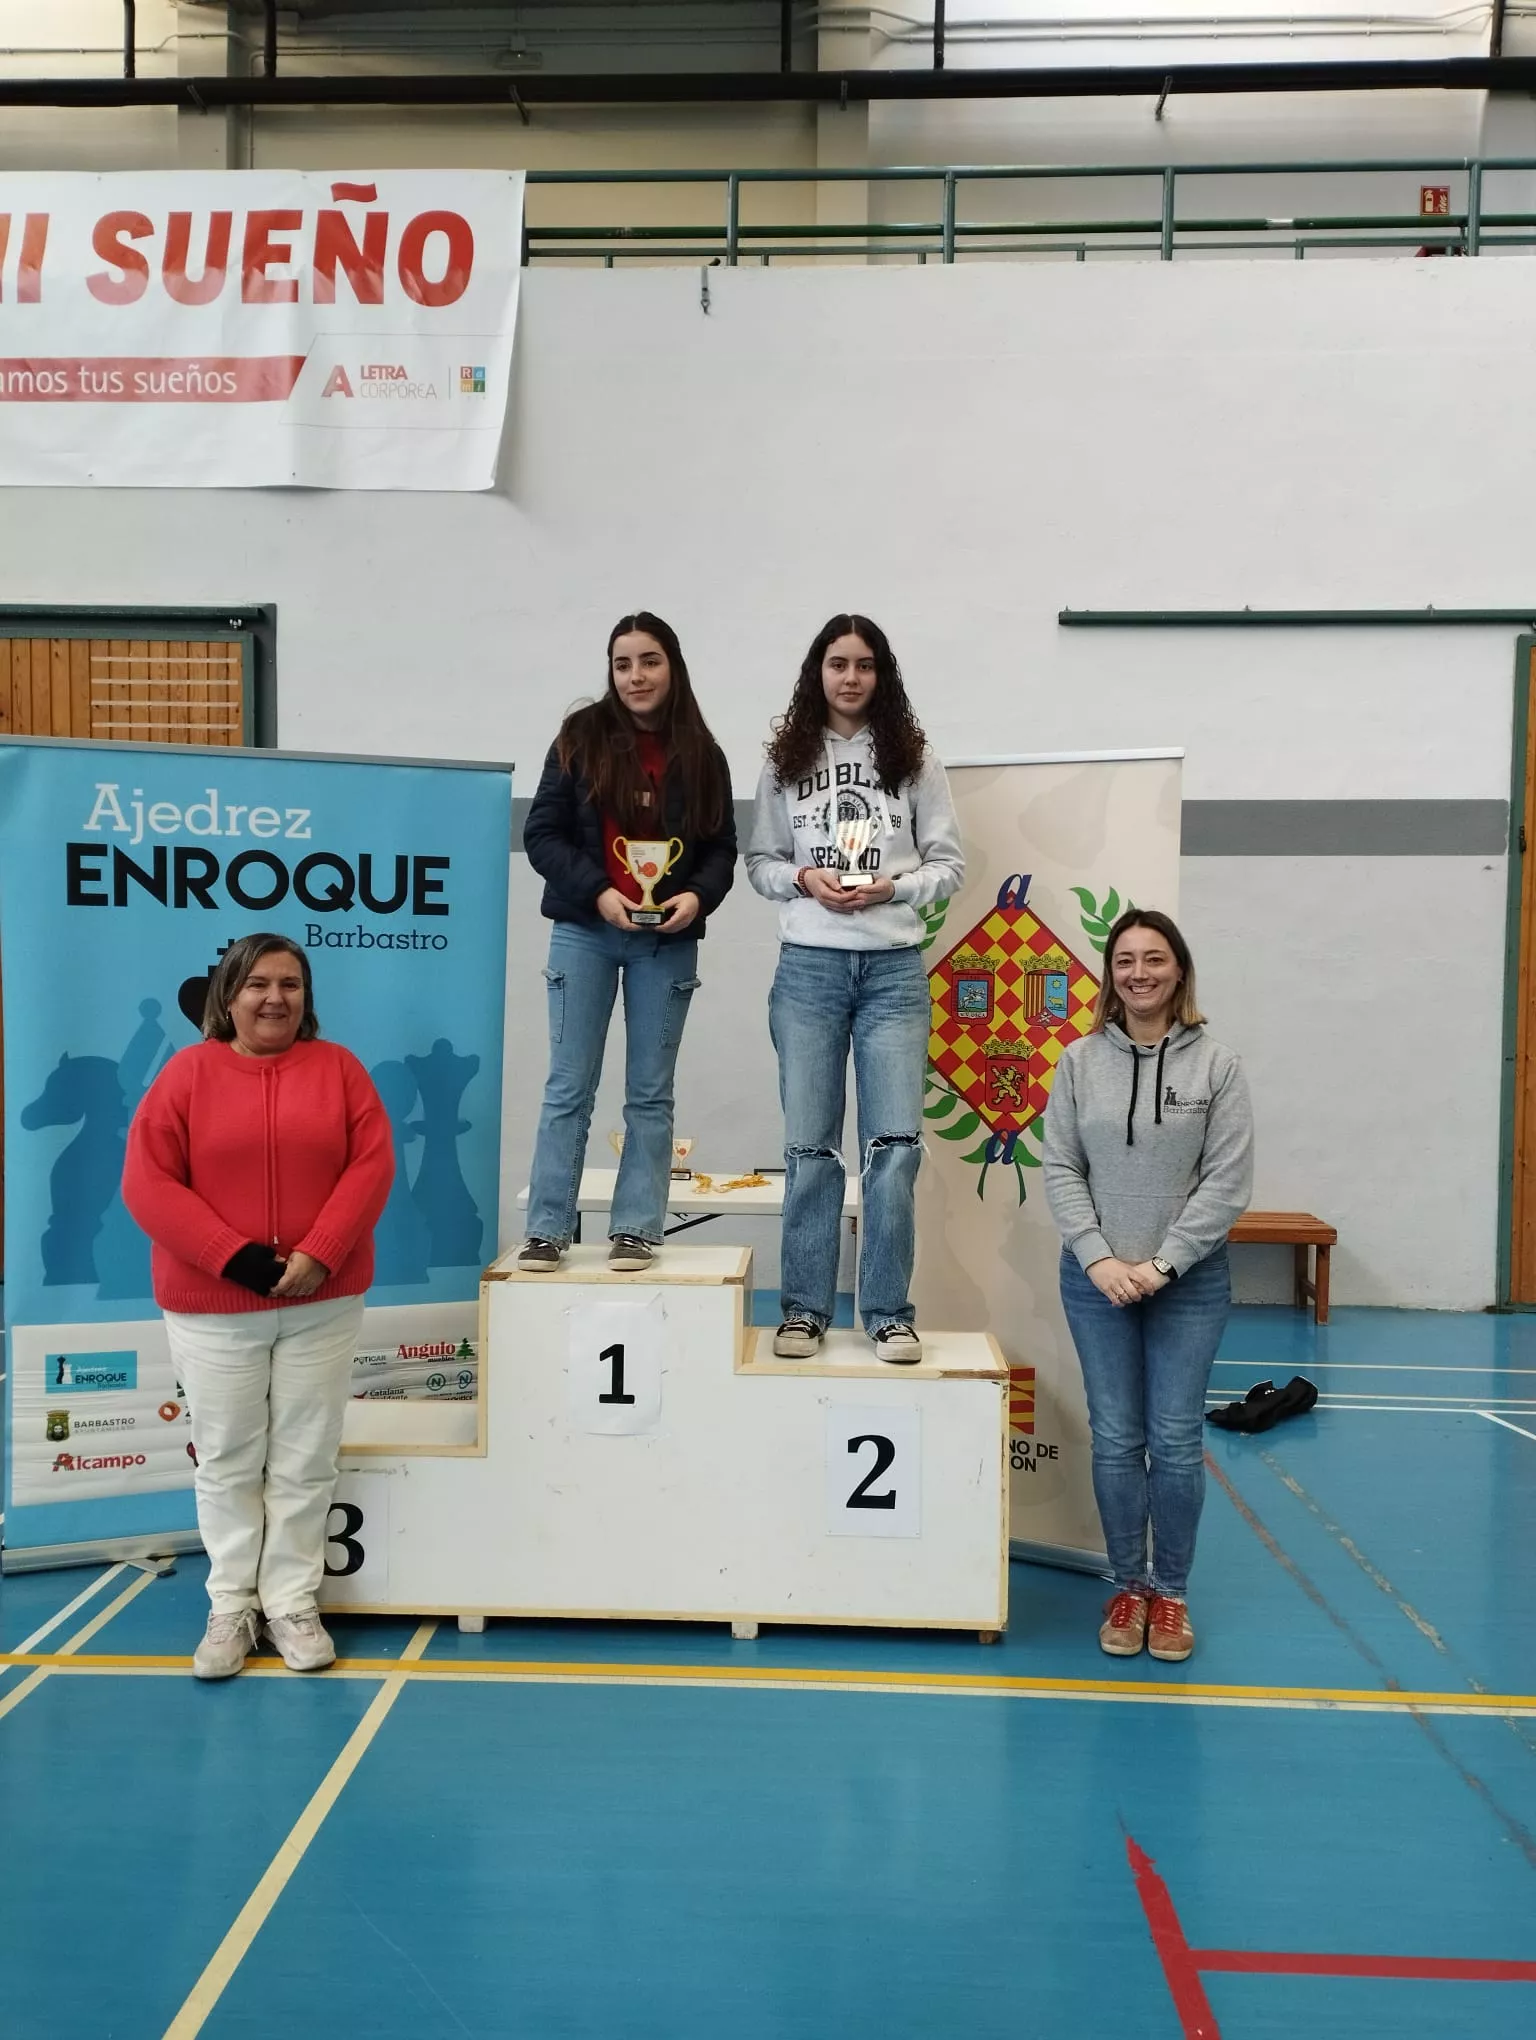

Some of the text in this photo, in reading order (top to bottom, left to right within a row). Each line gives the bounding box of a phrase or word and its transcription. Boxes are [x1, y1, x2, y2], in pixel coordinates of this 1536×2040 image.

[86, 182, 474, 307] SUEÑO
[78, 366, 124, 394] tus
[133, 364, 238, 394] sueños
[360, 365, 408, 380] LETRA
[83, 783, 312, 845] Ajedrez
[66, 842, 450, 916] ENROQUE
[305, 923, 448, 951] Barbastro
[397, 1341, 456, 1359] Angulo
[75, 1372, 127, 1384] ENROQUE
[599, 1343, 635, 1404] 1
[74, 1417, 136, 1428] BARBASTRO
[1036, 1443, 1059, 1459] DE
[846, 1434, 897, 1509] 2
[323, 1502, 365, 1577] 3
